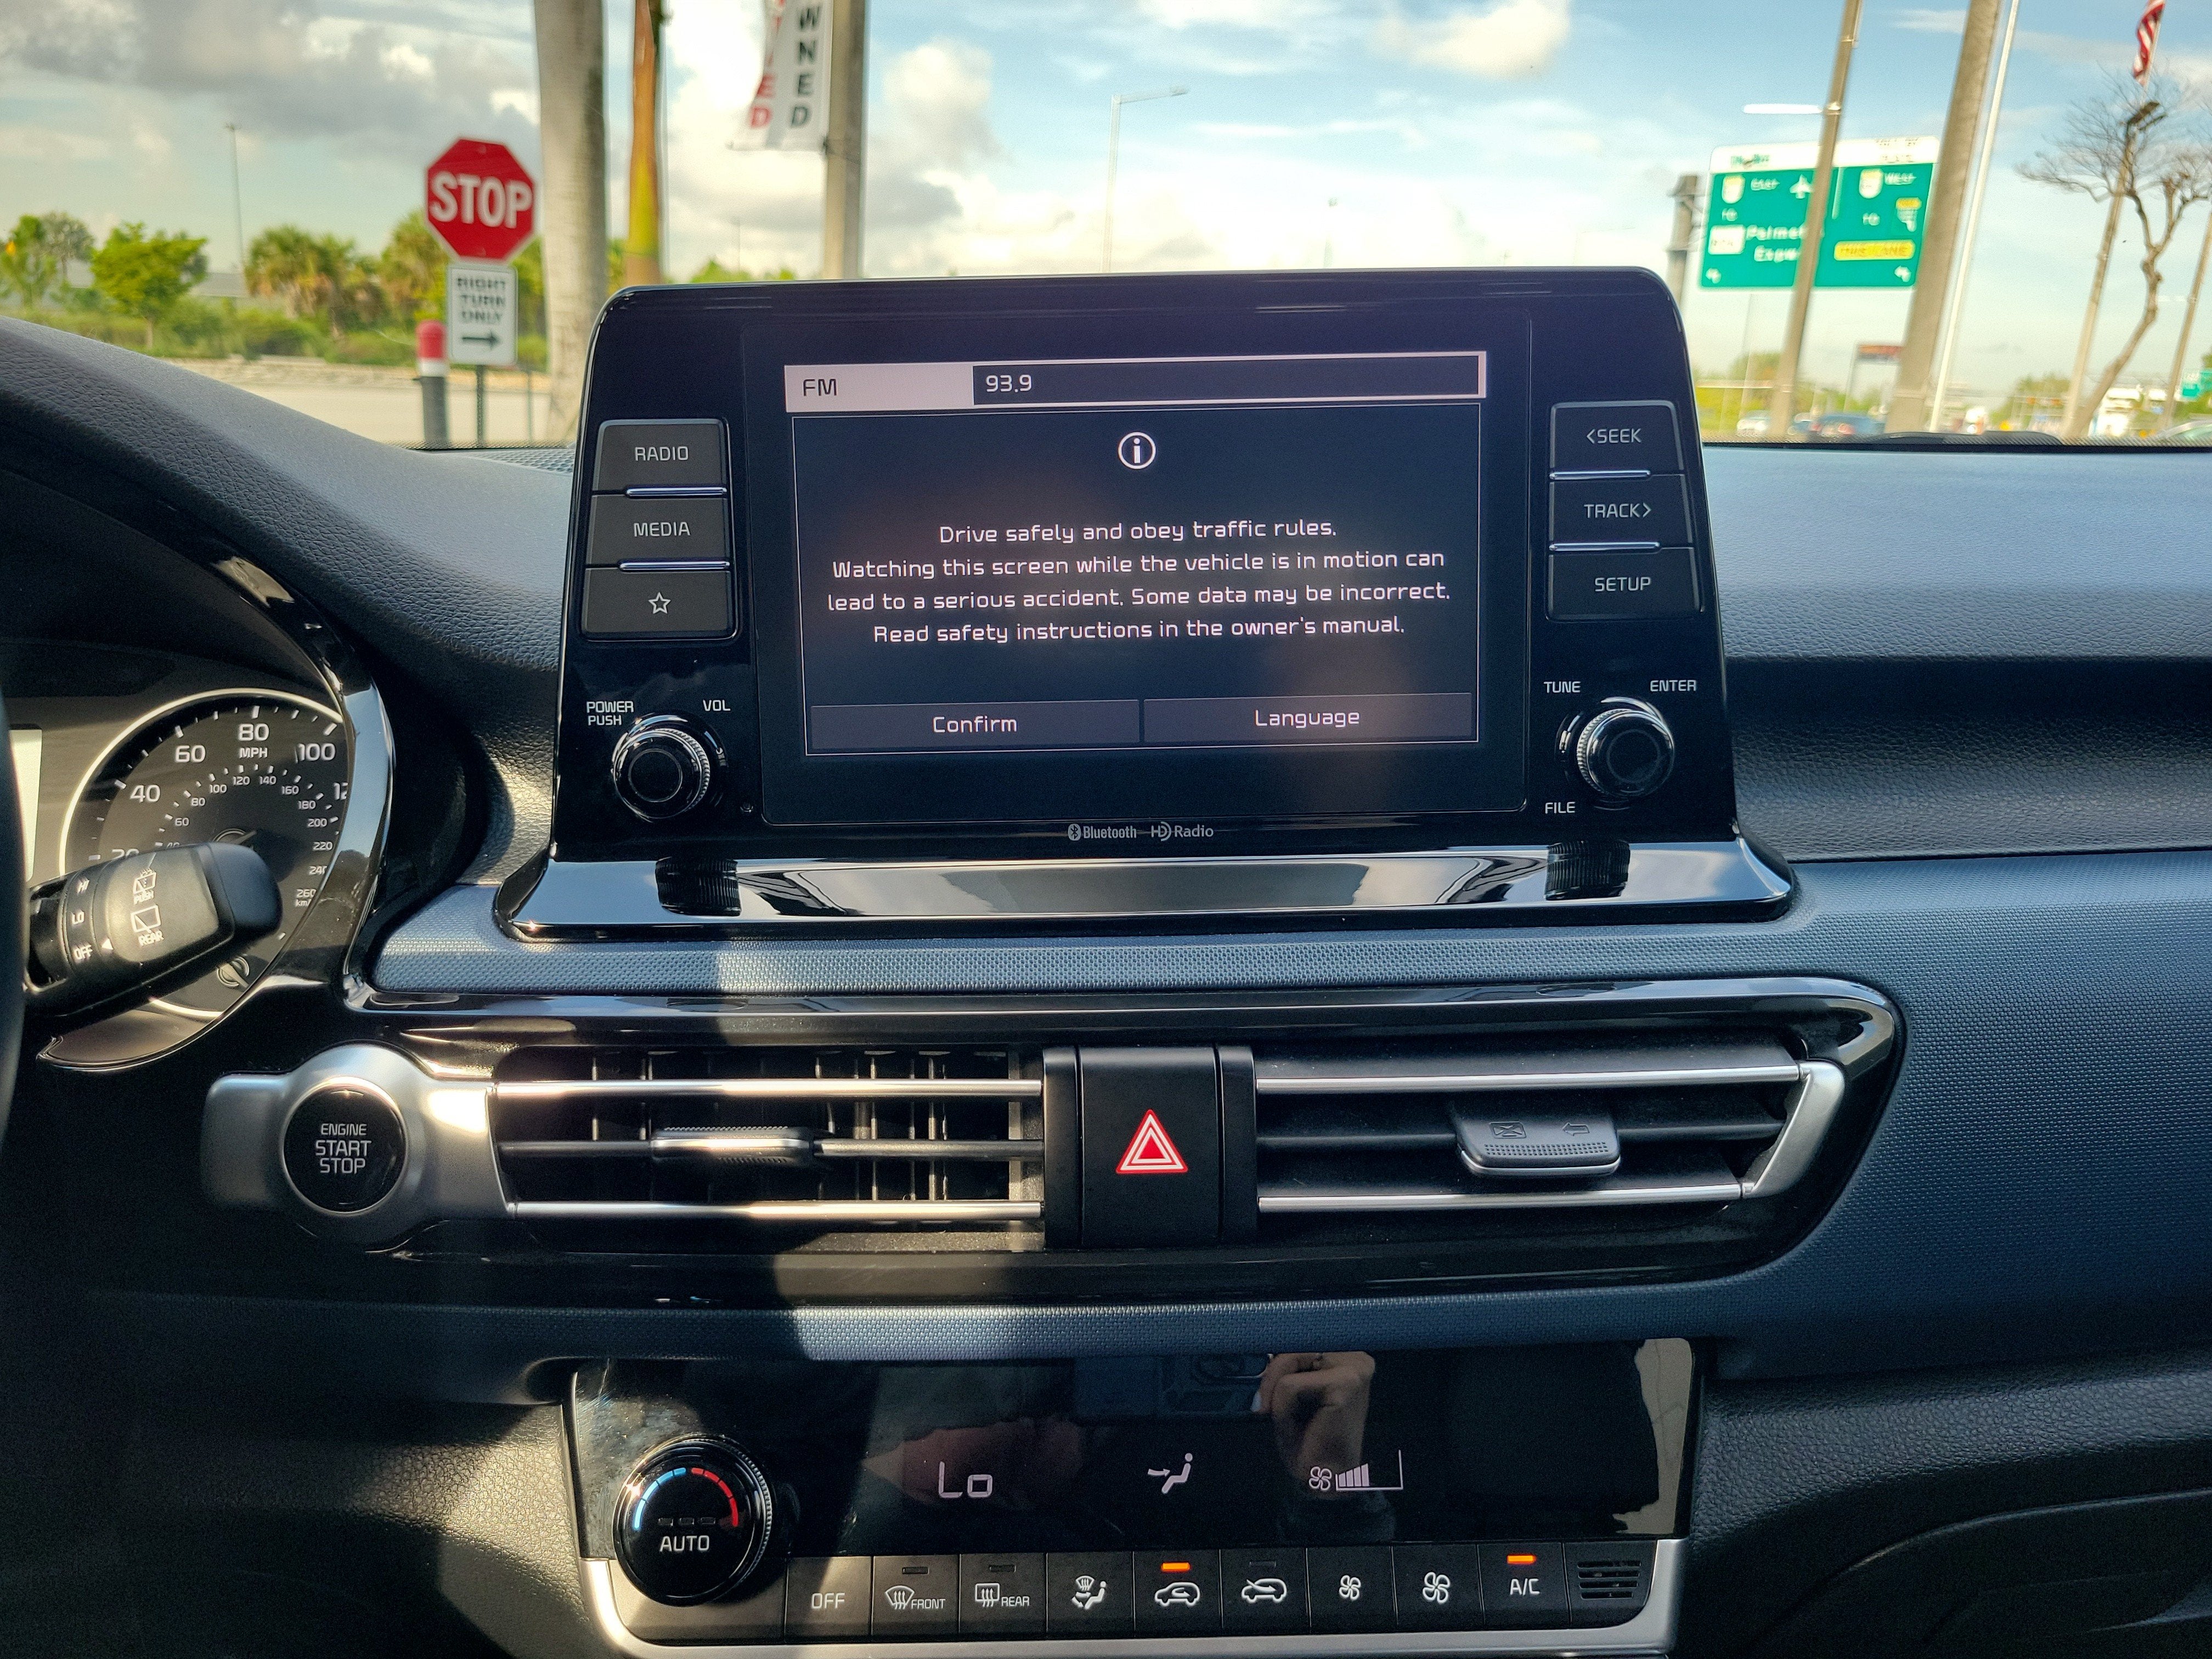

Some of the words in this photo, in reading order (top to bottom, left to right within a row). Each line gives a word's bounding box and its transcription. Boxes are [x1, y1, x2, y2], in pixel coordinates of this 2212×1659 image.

[430, 171, 533, 228] STOP
[456, 277, 506, 290] RIGHT
[460, 295, 505, 307] TURN
[461, 311, 502, 324] ONLY
[803, 379, 837, 397] FM
[985, 374, 1032, 393] 93.9
[634, 446, 689, 461] RADIO
[634, 522, 691, 537] MEDIA
[940, 526, 997, 543] Drive
[1006, 524, 1074, 544] safely
[1083, 522, 1122, 540] and
[1131, 522, 1184, 541] obey
[1193, 520, 1266, 538] traffic
[1274, 520, 1336, 537] rules.
[833, 561, 934, 579] Watching
[943, 558, 984, 576] this
[992, 560, 1068, 575] screen
[1076, 557, 1132, 573] while
[1141, 555, 1177, 572] the
[1184, 553, 1263, 571] vehicle
[1272, 553, 1289, 569] is
[1297, 552, 1316, 569] in
[1323, 551, 1397, 568] motion
[1406, 552, 1444, 567] can
[1594, 577, 1651, 592] SETUP
[828, 594, 874, 611] lead
[883, 594, 905, 610] to
[913, 596, 925, 608] a
[934, 591, 1015, 608] serious
[1023, 590, 1124, 607] accident.
[1132, 588, 1189, 605] Some
[1198, 586, 1246, 603] data
[1255, 589, 1297, 604] may
[1306, 585, 1332, 601] be
[1340, 582, 1450, 601] incorrect.
[874, 626, 929, 642] Read
[937, 624, 1007, 642] safety
[1017, 620, 1152, 640] instructions
[1159, 620, 1178, 637] in
[1187, 619, 1223, 636] the
[1231, 617, 1316, 635] owner's
[1323, 616, 1404, 634] manual.
[1544, 681, 1581, 693] TUNE
[1650, 679, 1697, 692] ENTER
[586, 701, 634, 713] POWER
[702, 699, 731, 712] VOL
[588, 715, 622, 725] PUSH
[933, 715, 1018, 733] Confirm
[1255, 709, 1361, 729] Language
[239, 724, 269, 741] 80
[175, 745, 206, 763] 60
[239, 747, 268, 758] MPH
[298, 743, 336, 762] 100
[232, 776, 250, 786] 120
[259, 776, 276, 785] 140
[130, 785, 161, 803] 40
[209, 784, 227, 794] 100
[281, 786, 299, 794] 160
[191, 798, 205, 807] 80
[298, 800, 316, 810] 180
[1545, 802, 1576, 814] FILE
[174, 817, 189, 826] 60
[307, 819, 327, 827] 200
[1083, 825, 1137, 839] Bluetooth
[1175, 825, 1214, 837] Radio
[313, 842, 332, 851] 220
[77, 878, 89, 893] HI
[133, 889, 155, 904] PUSH
[71, 911, 84, 925] LO
[138, 929, 164, 946] REAR
[74, 944, 93, 960] OFF
[321, 1124, 366, 1136] ENGINE
[315, 1140, 371, 1156] START
[320, 1158, 365, 1174] STOP
[659, 1535, 710, 1552] AUTO
[1510, 1578, 1541, 1595] A/C
[811, 1593, 845, 1609] OFF
[911, 1597, 946, 1610] FRONT
[1001, 1595, 1030, 1608] REAR
